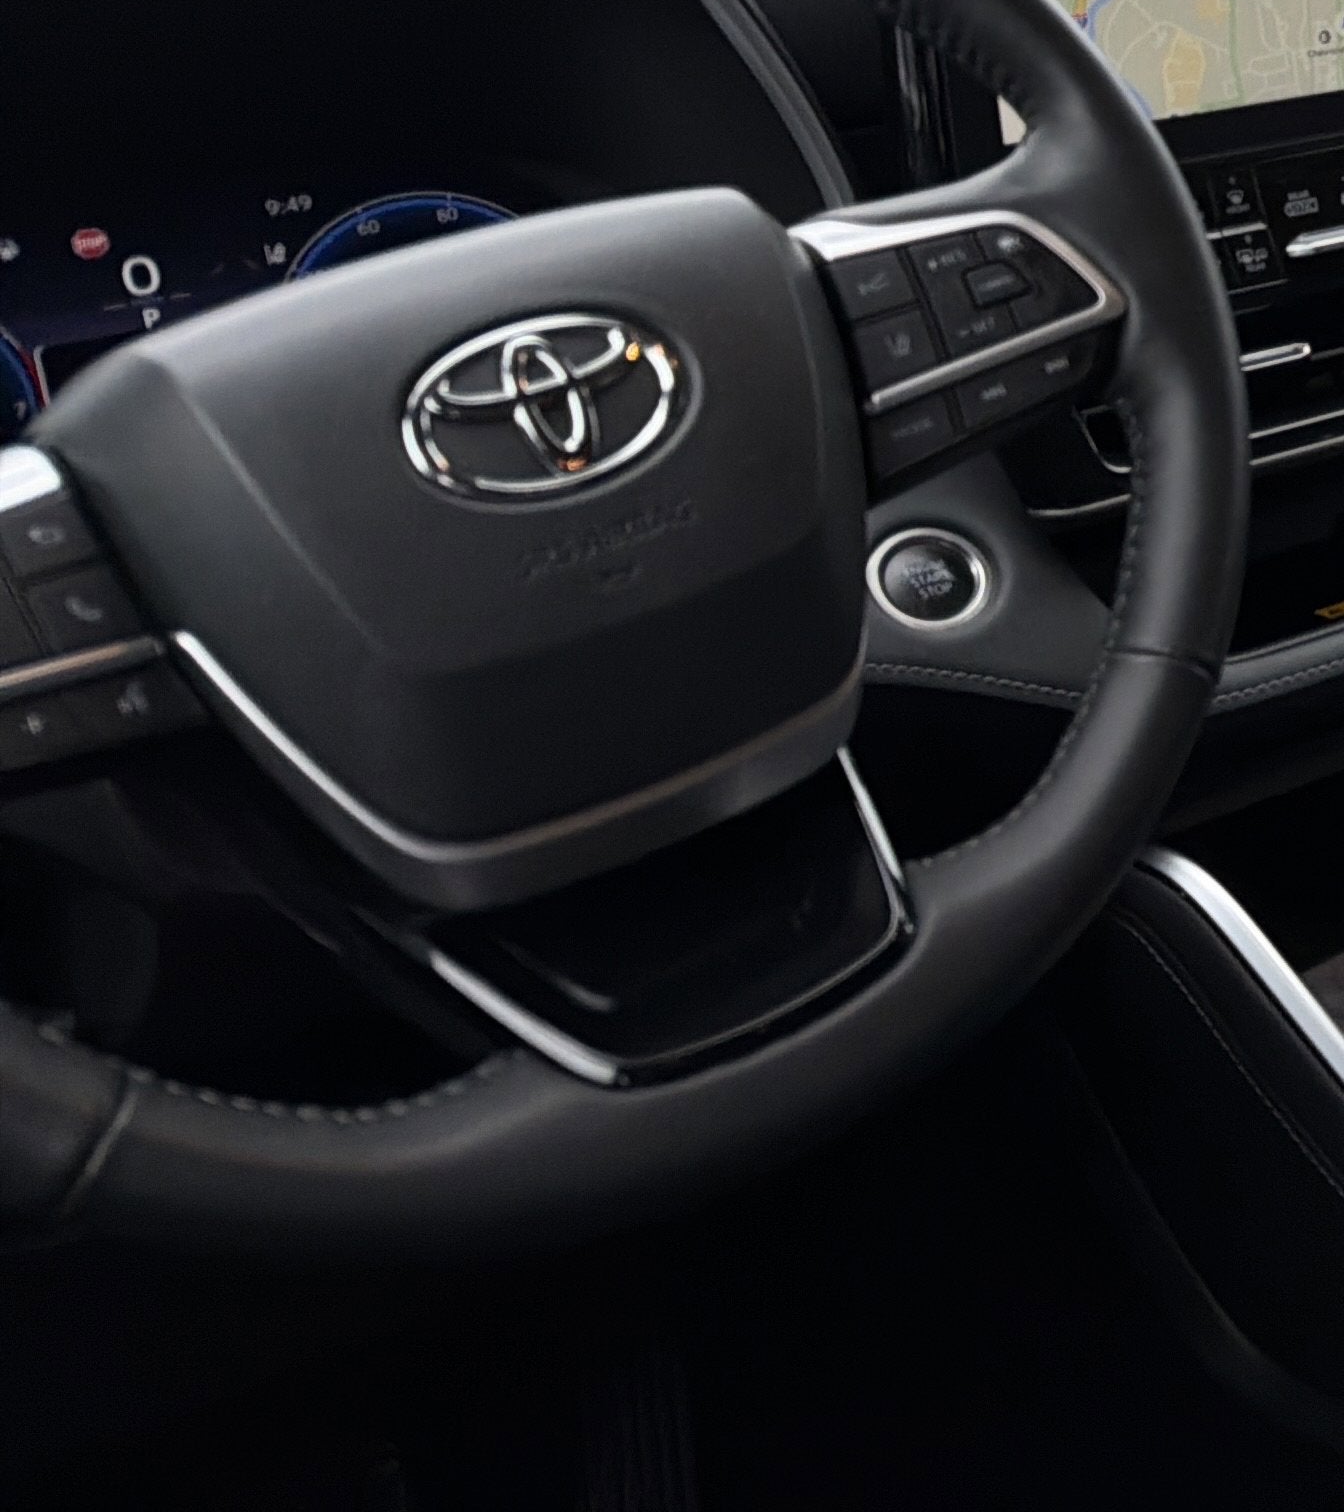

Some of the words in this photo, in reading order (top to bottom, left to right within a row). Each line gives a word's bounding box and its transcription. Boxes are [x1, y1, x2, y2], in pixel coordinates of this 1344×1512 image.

[265, 193, 314, 217] 9:49
[357, 219, 381, 237] 60
[121, 255, 161, 296] 0
[142, 308, 161, 330] P
